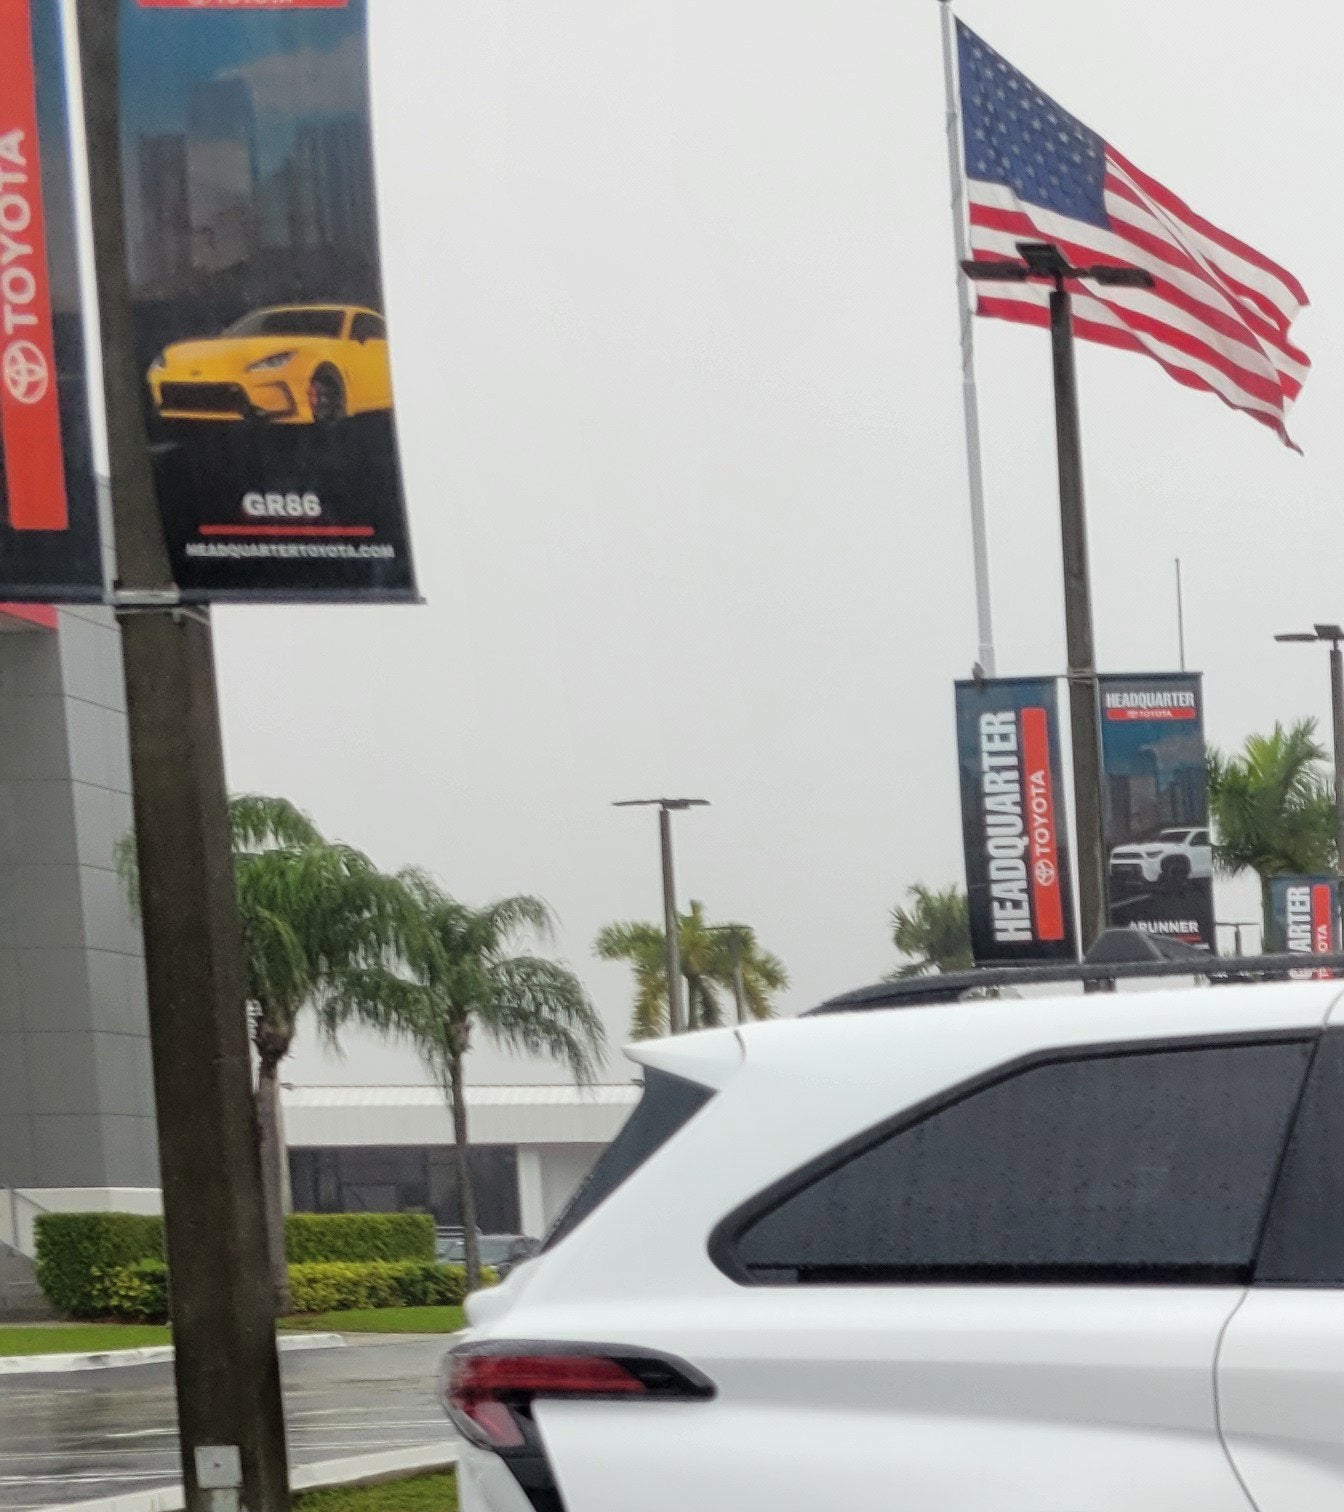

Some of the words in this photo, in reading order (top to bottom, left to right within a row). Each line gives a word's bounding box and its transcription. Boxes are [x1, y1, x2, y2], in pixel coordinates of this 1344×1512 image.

[0, 128, 38, 335] TOYOTA
[242, 491, 321, 517] GR86
[1106, 691, 1195, 709] HEADQUARTER
[980, 711, 1032, 941] HEADQUARTER
[1030, 770, 1051, 856] TOYOTA
